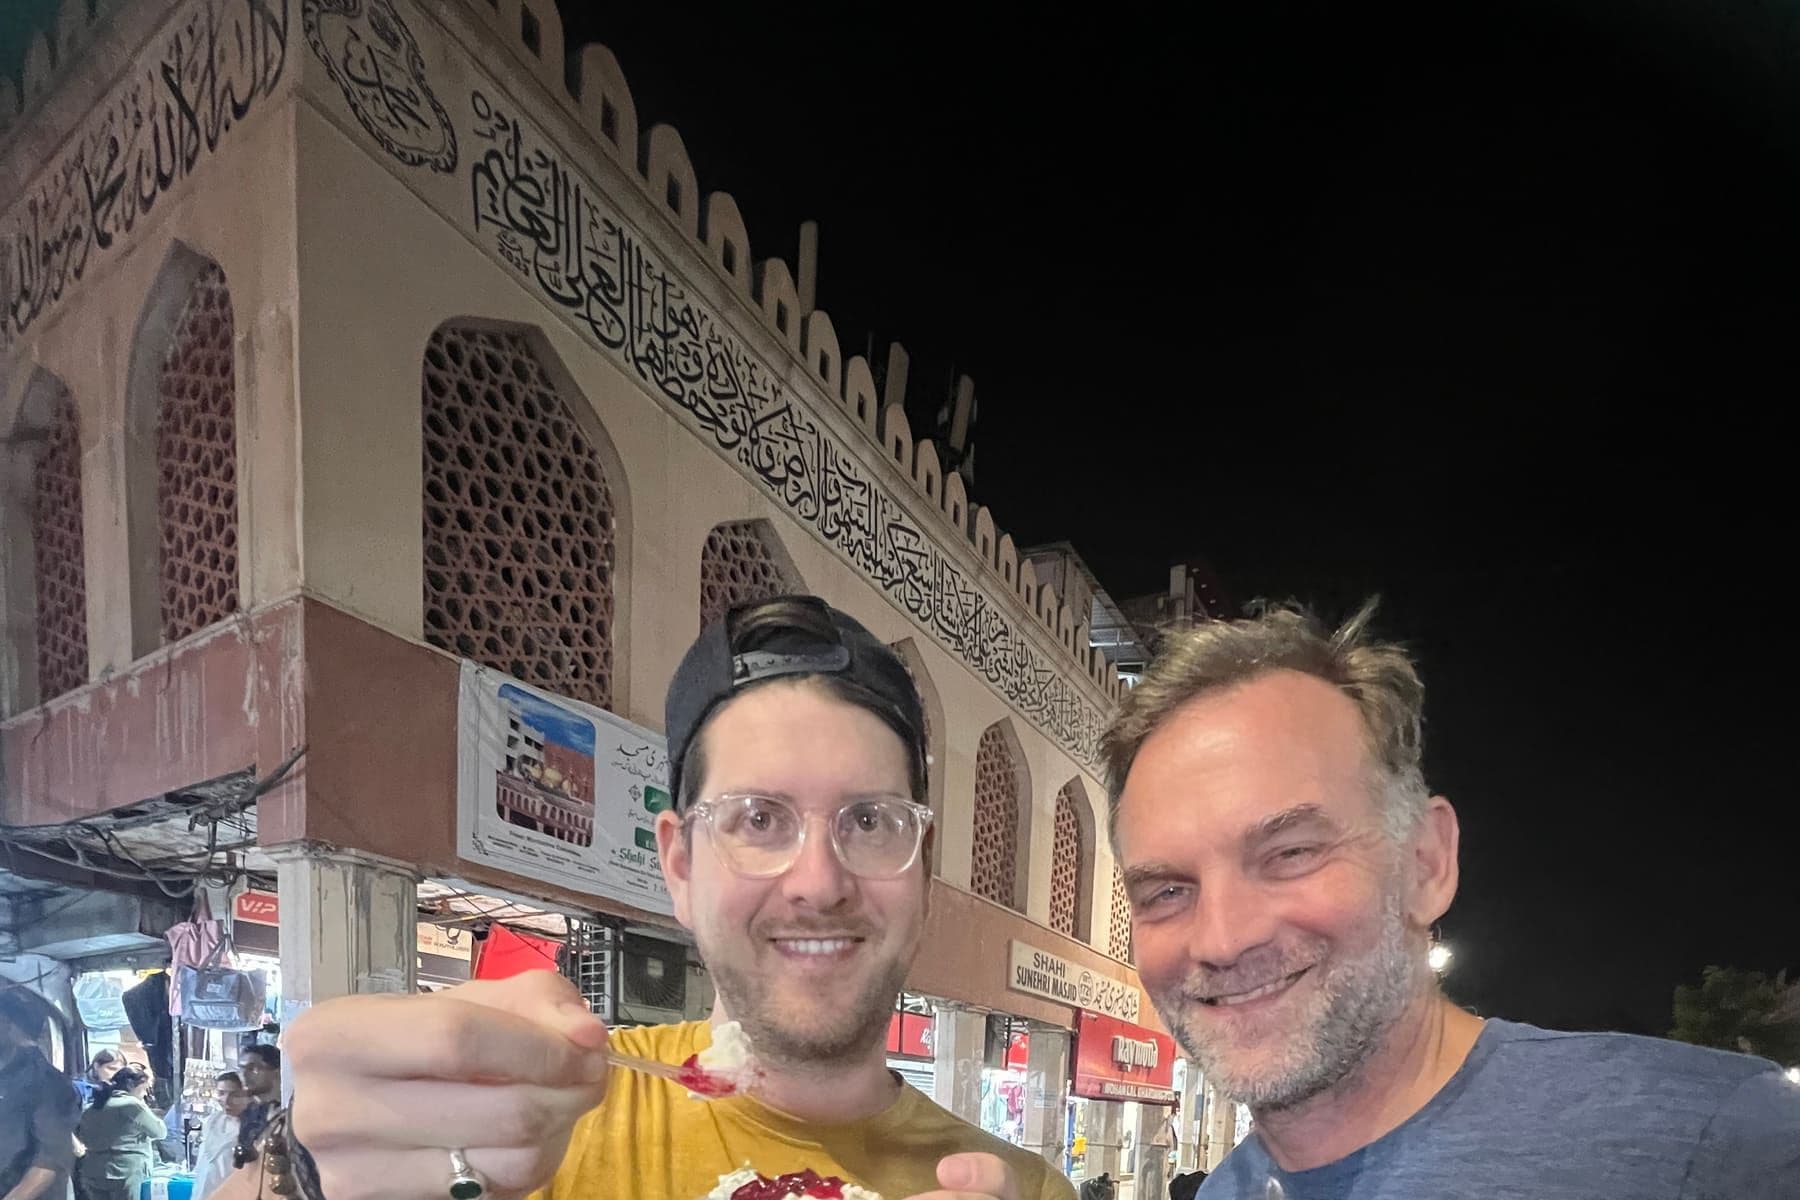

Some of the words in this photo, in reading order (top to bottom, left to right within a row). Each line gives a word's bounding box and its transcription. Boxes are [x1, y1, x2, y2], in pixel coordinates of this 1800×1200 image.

[240, 898, 277, 914] VIP
[1033, 952, 1066, 978] SHAHI
[1016, 965, 1050, 993] SUNEHRI
[1051, 977, 1077, 1001] MASJID
